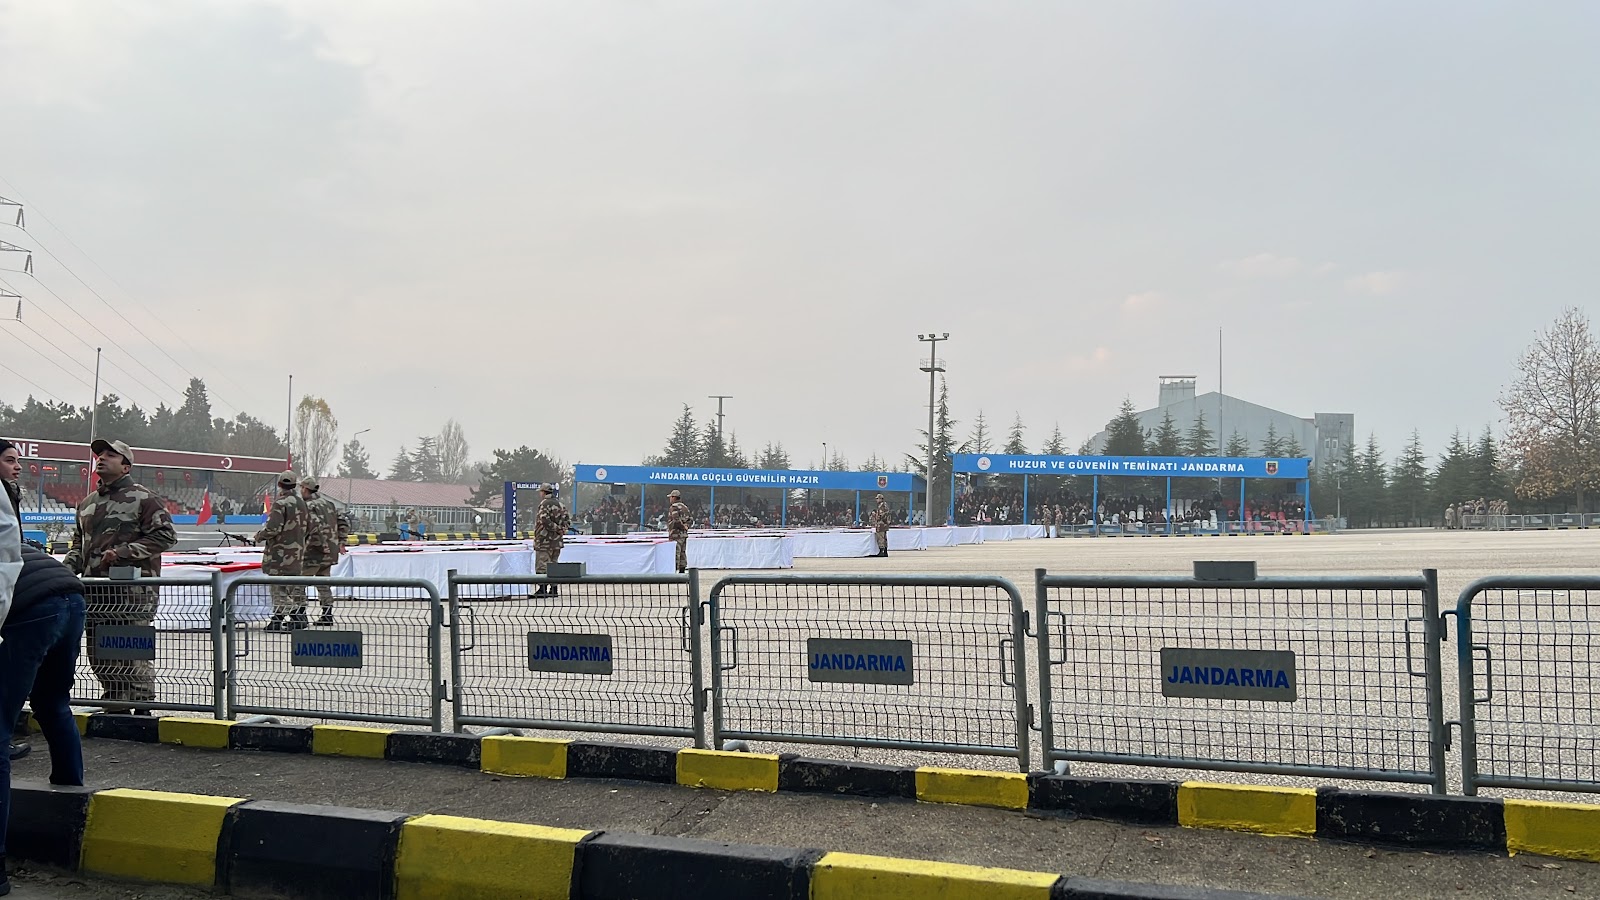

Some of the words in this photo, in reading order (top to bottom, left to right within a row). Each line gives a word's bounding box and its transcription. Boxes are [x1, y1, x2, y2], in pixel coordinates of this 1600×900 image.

[1009, 460, 1047, 469] HUZUR
[1050, 461, 1065, 469] VE
[1068, 459, 1119, 470] GÜVENİN
[1123, 460, 1177, 471] TEMİNATI
[1181, 462, 1245, 472] JANDARMA
[649, 472, 699, 481] JANDARMA
[702, 472, 733, 483] GÜÇLÜ
[736, 473, 787, 483] GÜVENİLİR
[789, 475, 819, 484] HAZIR
[100, 636, 154, 650] JANDARMA
[294, 643, 360, 657] JANDARMA
[532, 645, 611, 662] JANDARMA
[811, 653, 906, 672] JANDARMA
[1167, 665, 1290, 689] JANDARMA
